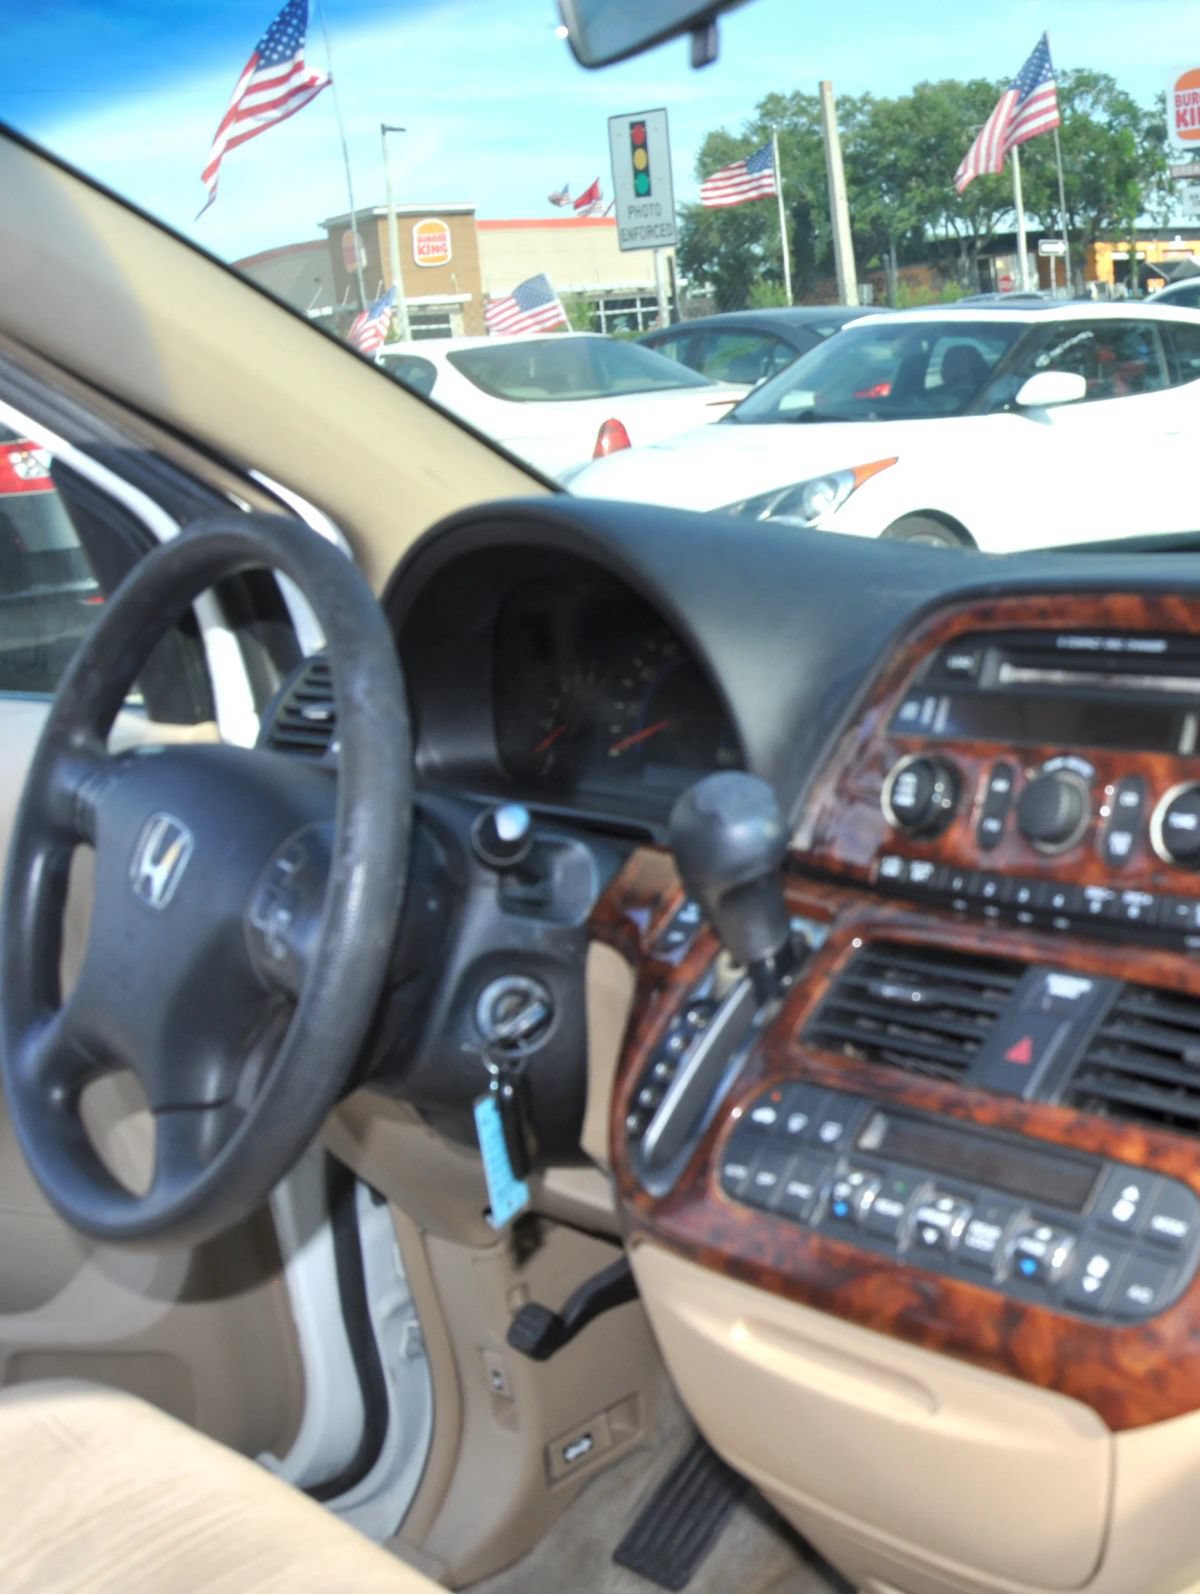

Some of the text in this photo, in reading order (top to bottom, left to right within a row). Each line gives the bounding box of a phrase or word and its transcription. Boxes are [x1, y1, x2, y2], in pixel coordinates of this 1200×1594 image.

[627, 203, 662, 219] PHOTO
[621, 223, 673, 242] ENFORCED
[418, 243, 448, 255] KING
